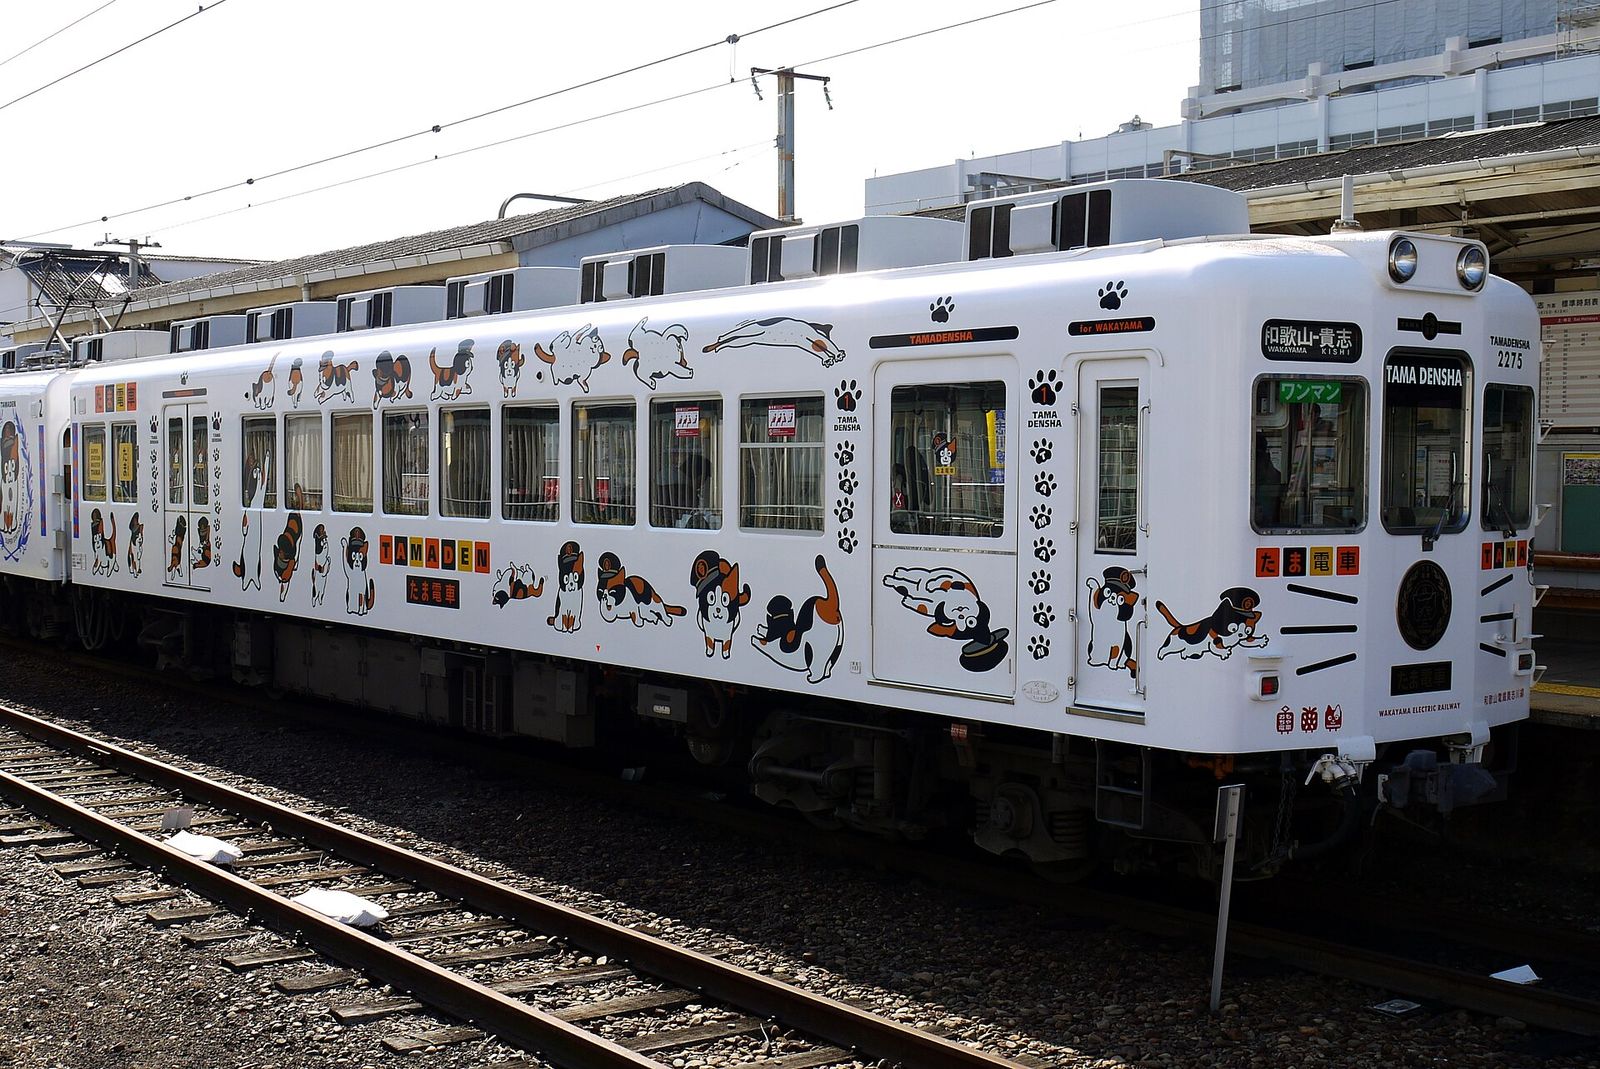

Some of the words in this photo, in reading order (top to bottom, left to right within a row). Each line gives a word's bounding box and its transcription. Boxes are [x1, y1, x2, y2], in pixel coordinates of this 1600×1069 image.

[1079, 324, 1093, 334] for
[1095, 321, 1144, 333] WAKAYAMA
[909, 331, 974, 345] TAMADENSHA
[1490, 335, 1531, 350] TAMADENSHA
[1267, 345, 1308, 354] WAKAYAMA
[1321, 348, 1350, 356] KISHI
[1498, 350, 1523, 369] 2275
[1386, 364, 1417, 385] TAMA
[1419, 367, 1463, 387] DENSHA
[1041, 386, 1047, 403] 1
[1281, 383, 1340, 401] ワンマン
[38, 399, 43, 418] 2
[73, 396, 77, 415] 1
[844, 394, 849, 408] 1
[837, 416, 858, 424] TAMA
[1032, 411, 1058, 419] TAMA
[833, 423, 861, 432] DENSHA
[1028, 420, 1062, 428] DENSHA
[381, 541, 488, 568] TAMADEN
[1483, 544, 1527, 564] TAMA
[1260, 551, 1357, 574] たま電車
[409, 580, 456, 604] たま電車
[1379, 707, 1411, 717] WAKAYAMA
[1412, 705, 1436, 714] ELECTRIC
[1437, 702, 1461, 712] RAILWAY
